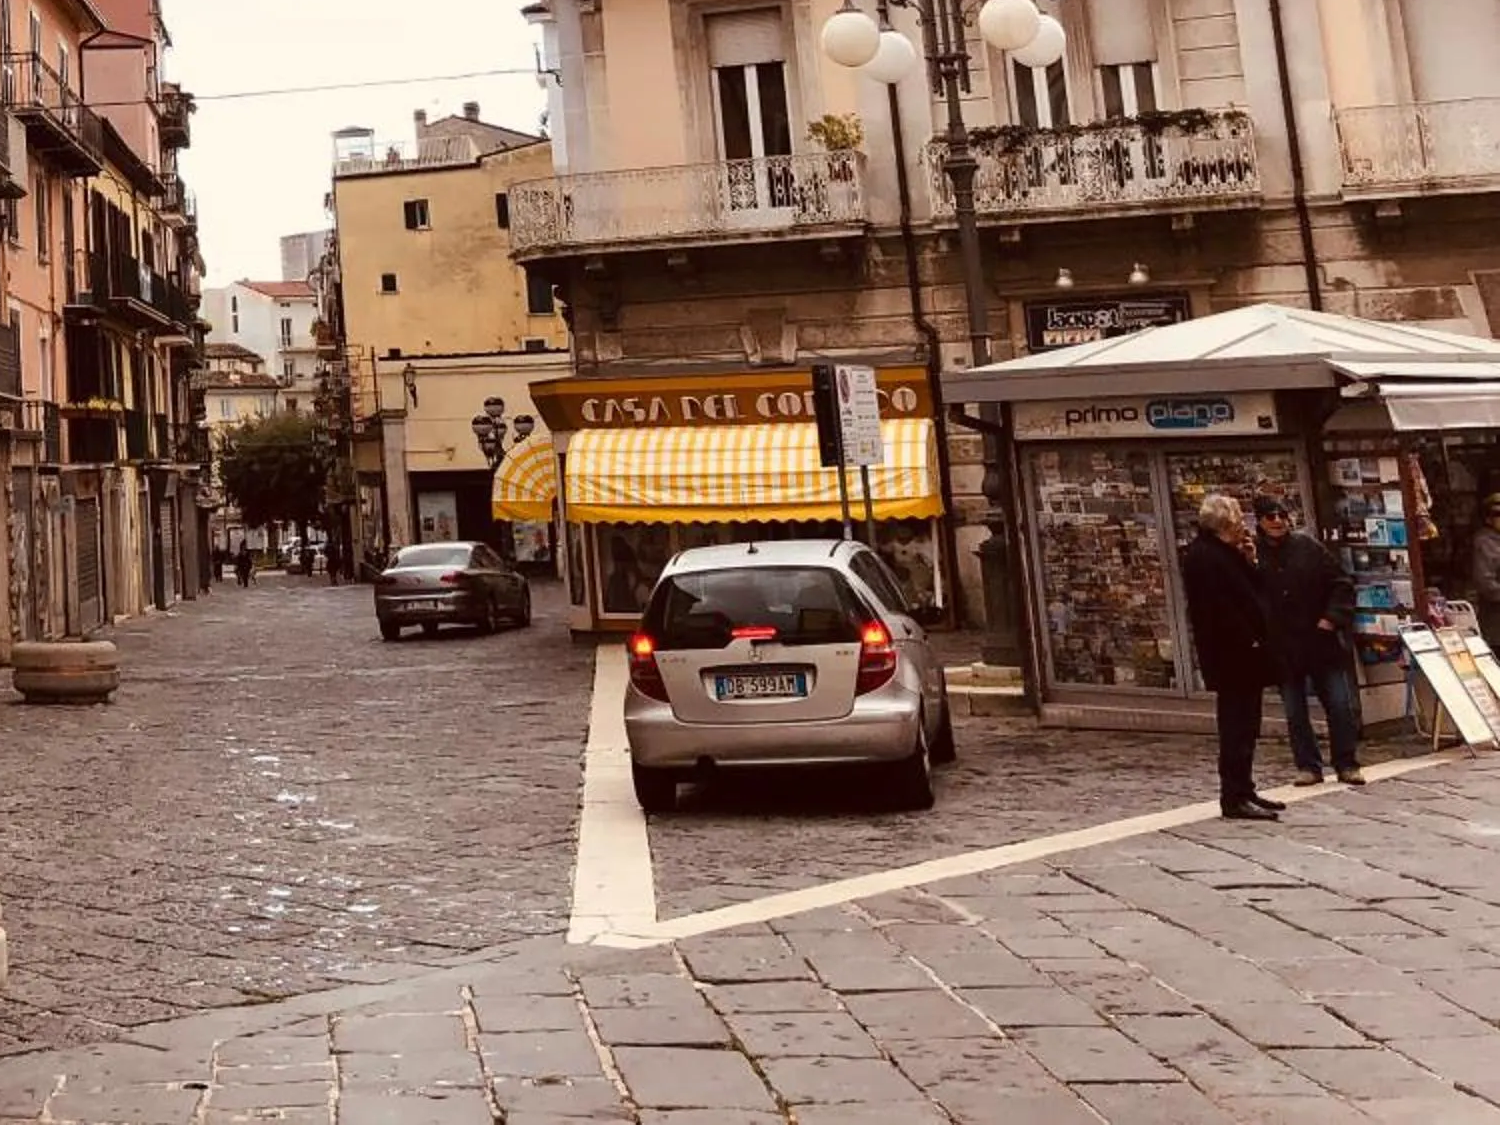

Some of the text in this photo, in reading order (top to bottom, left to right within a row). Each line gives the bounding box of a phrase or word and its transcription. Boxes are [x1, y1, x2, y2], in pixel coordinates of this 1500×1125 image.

[581, 396, 671, 423] CASA
[680, 392, 747, 420] DEL
[1065, 404, 1139, 427] primo
